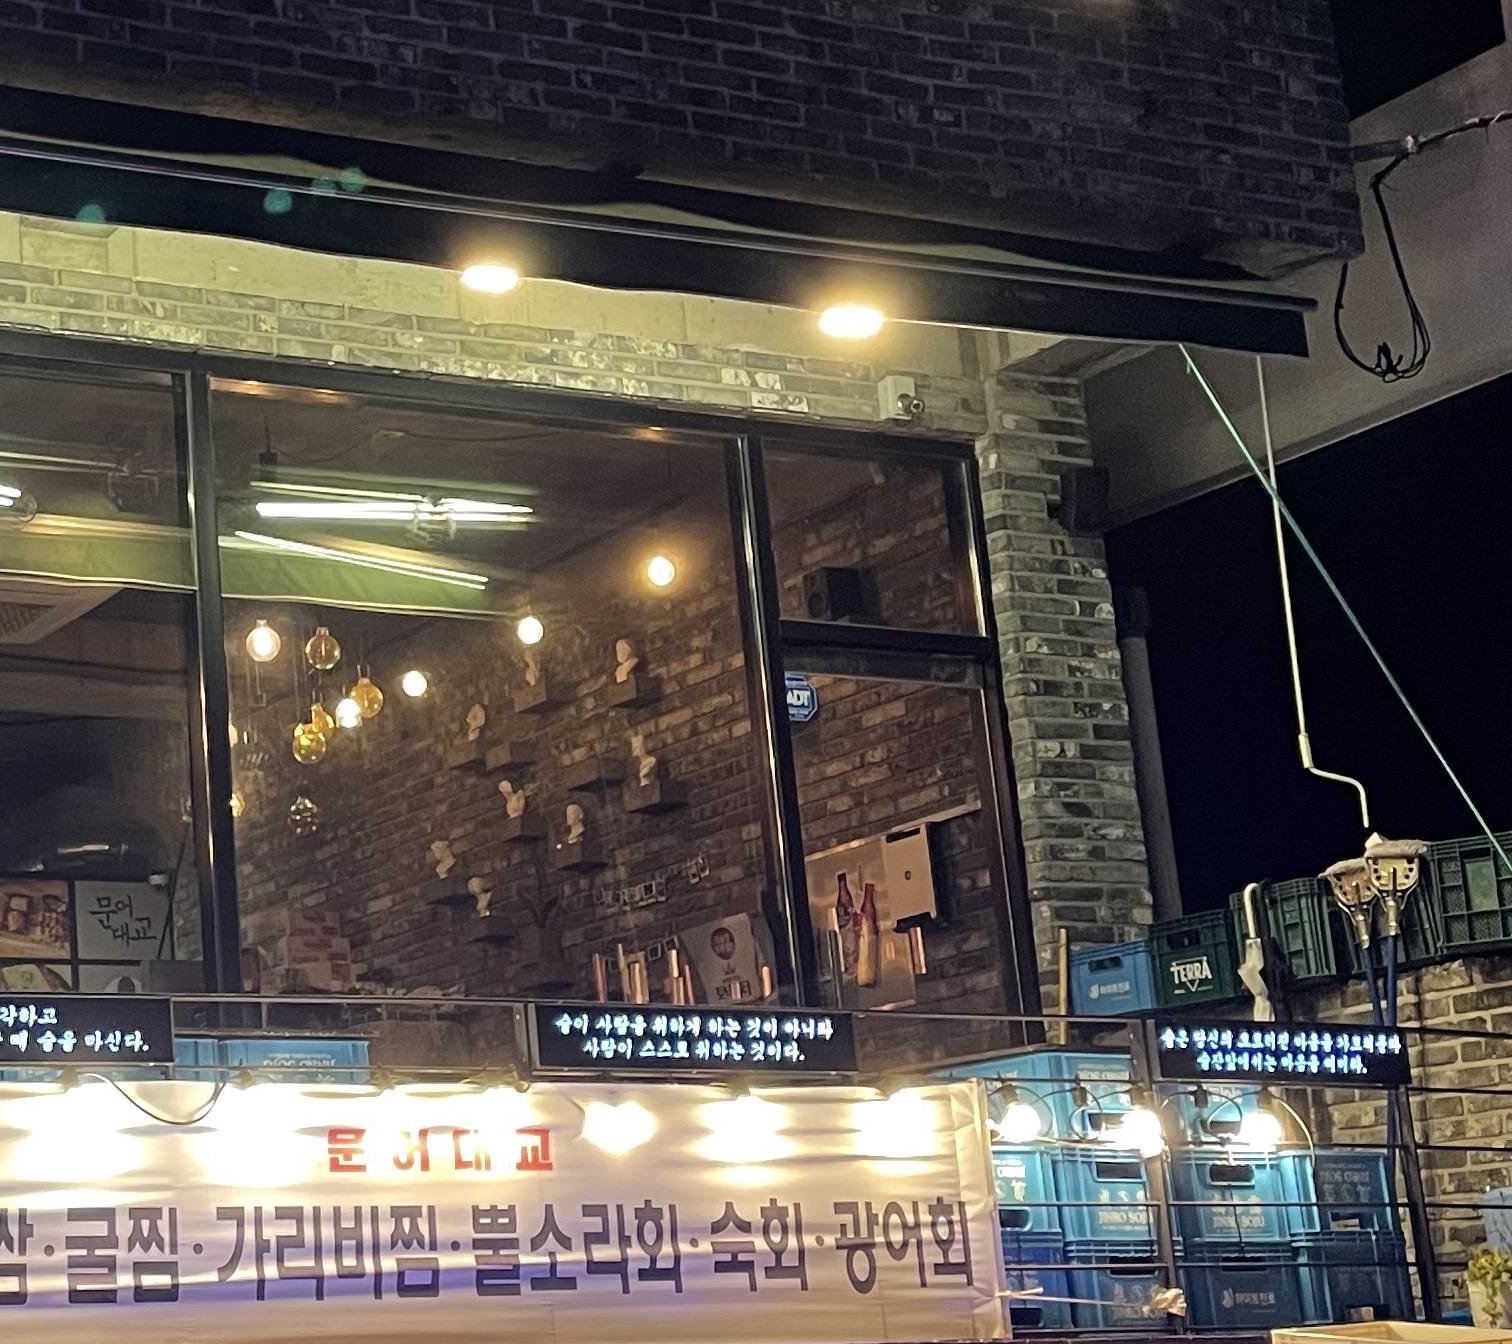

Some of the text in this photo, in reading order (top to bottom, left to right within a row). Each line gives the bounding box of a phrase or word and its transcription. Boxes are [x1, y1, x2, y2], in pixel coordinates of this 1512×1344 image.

[89, 894, 133, 930] 문어
[112, 916, 158, 948] 대교
[1170, 957, 1213, 984] TERRA
[555, 1012, 590, 1036] 술이
[595, 1013, 648, 1037] 사람을
[37, 1030, 78, 1052] 술을
[583, 1037, 634, 1060] 사람이
[639, 1038, 690, 1058] 스스로
